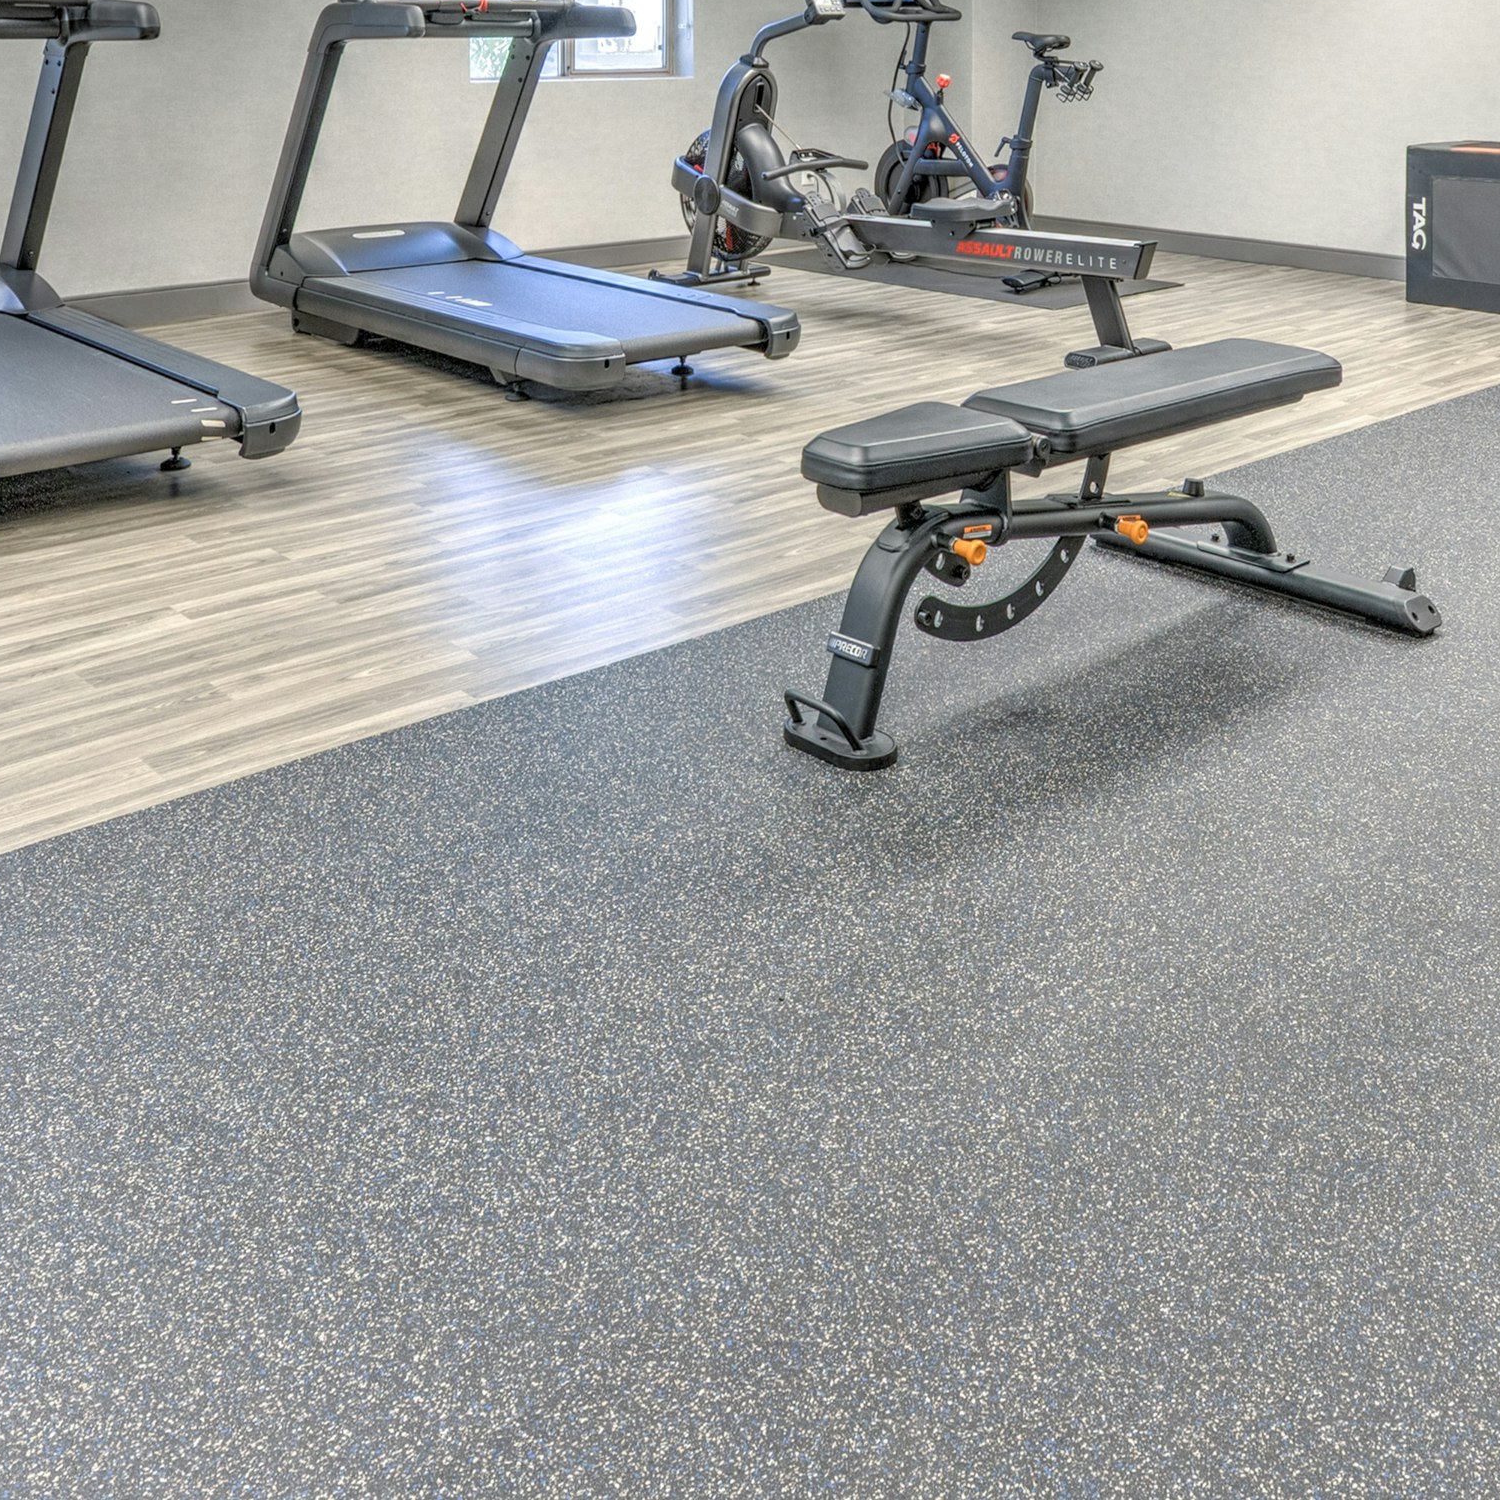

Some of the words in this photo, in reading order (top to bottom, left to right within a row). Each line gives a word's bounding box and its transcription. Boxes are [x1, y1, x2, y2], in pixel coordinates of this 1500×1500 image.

[955, 141, 974, 168] PELOTON
[1411, 196, 1428, 251] TAG
[835, 638, 869, 660] PRECOR
